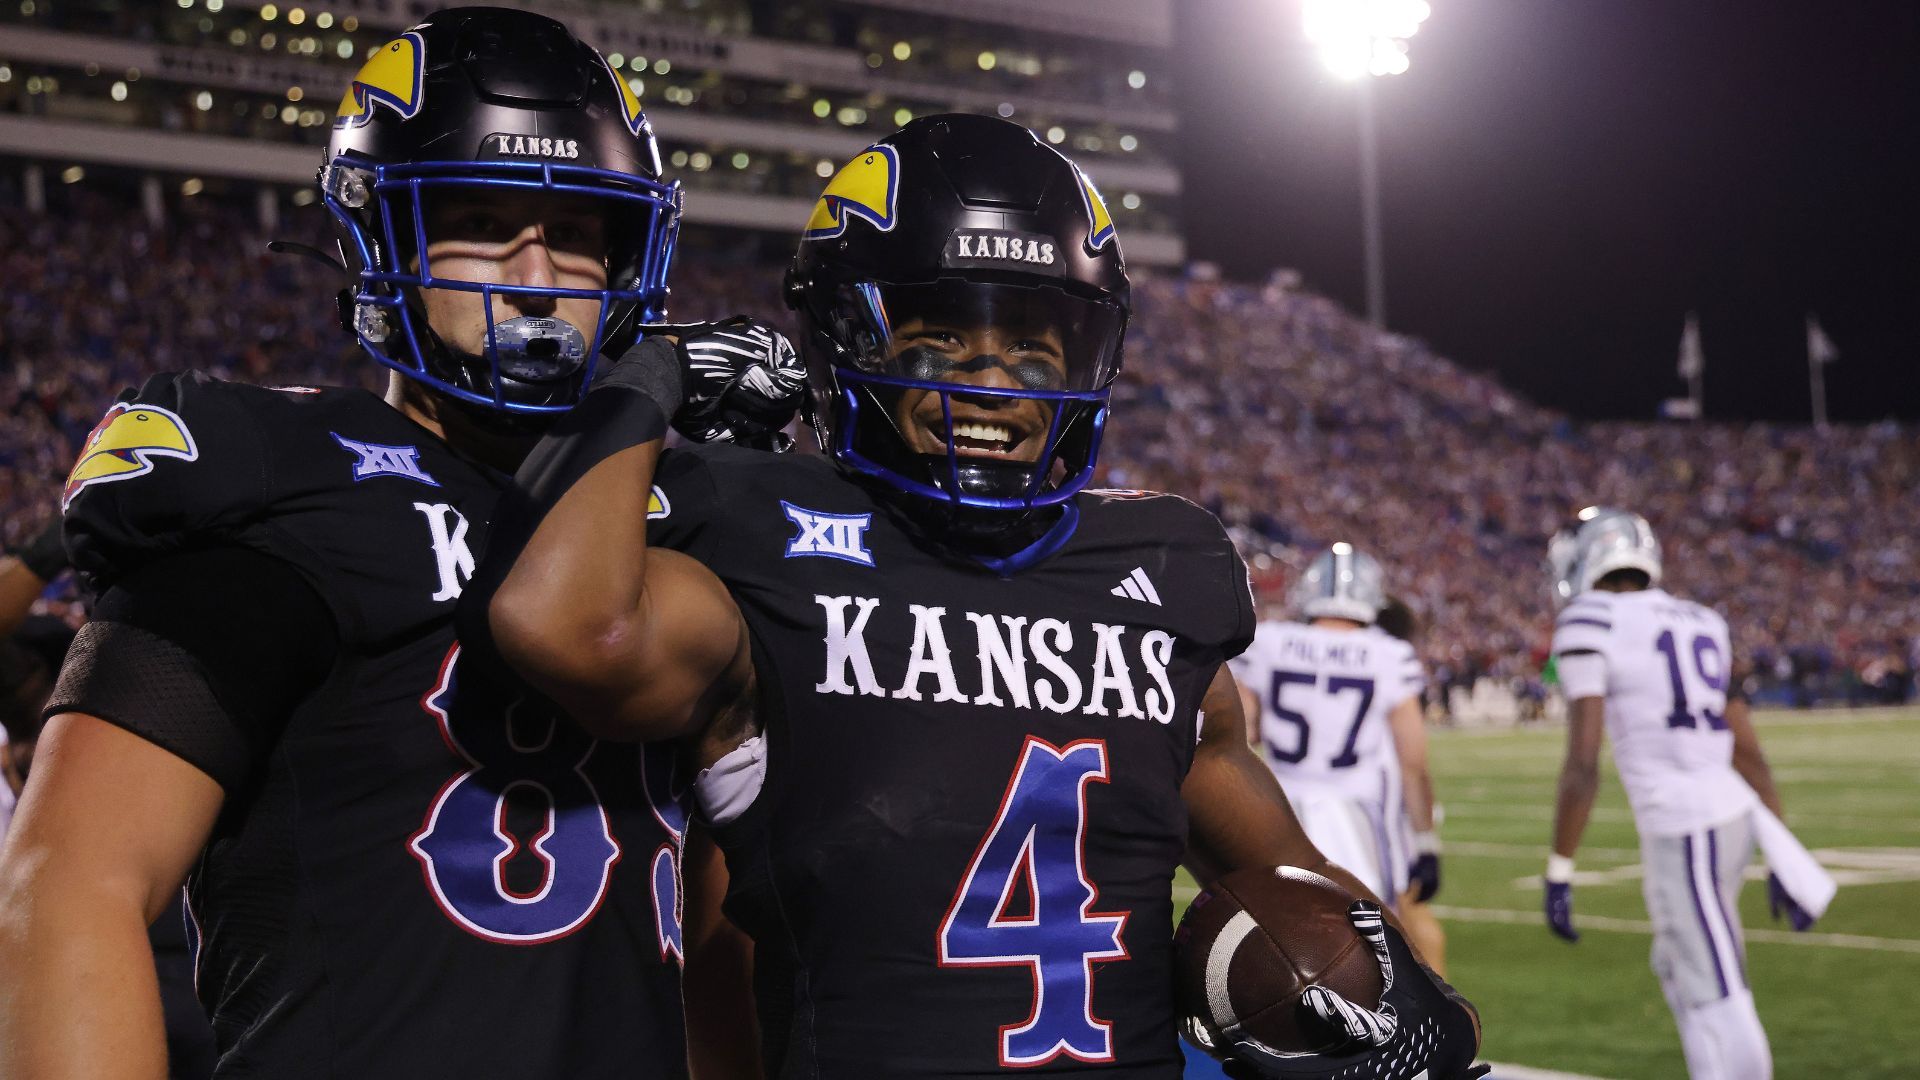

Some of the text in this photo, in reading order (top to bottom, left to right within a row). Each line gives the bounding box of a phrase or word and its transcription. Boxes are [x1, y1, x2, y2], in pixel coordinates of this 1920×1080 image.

[497, 135, 579, 159] KANSAS
[957, 235, 1055, 265] KANSAS
[814, 594, 1177, 725] KANSAS
[1281, 635, 1371, 668] PALMER
[1655, 628, 1732, 731] 19
[1265, 670, 1376, 769] 57
[937, 734, 1132, 1067] 4
